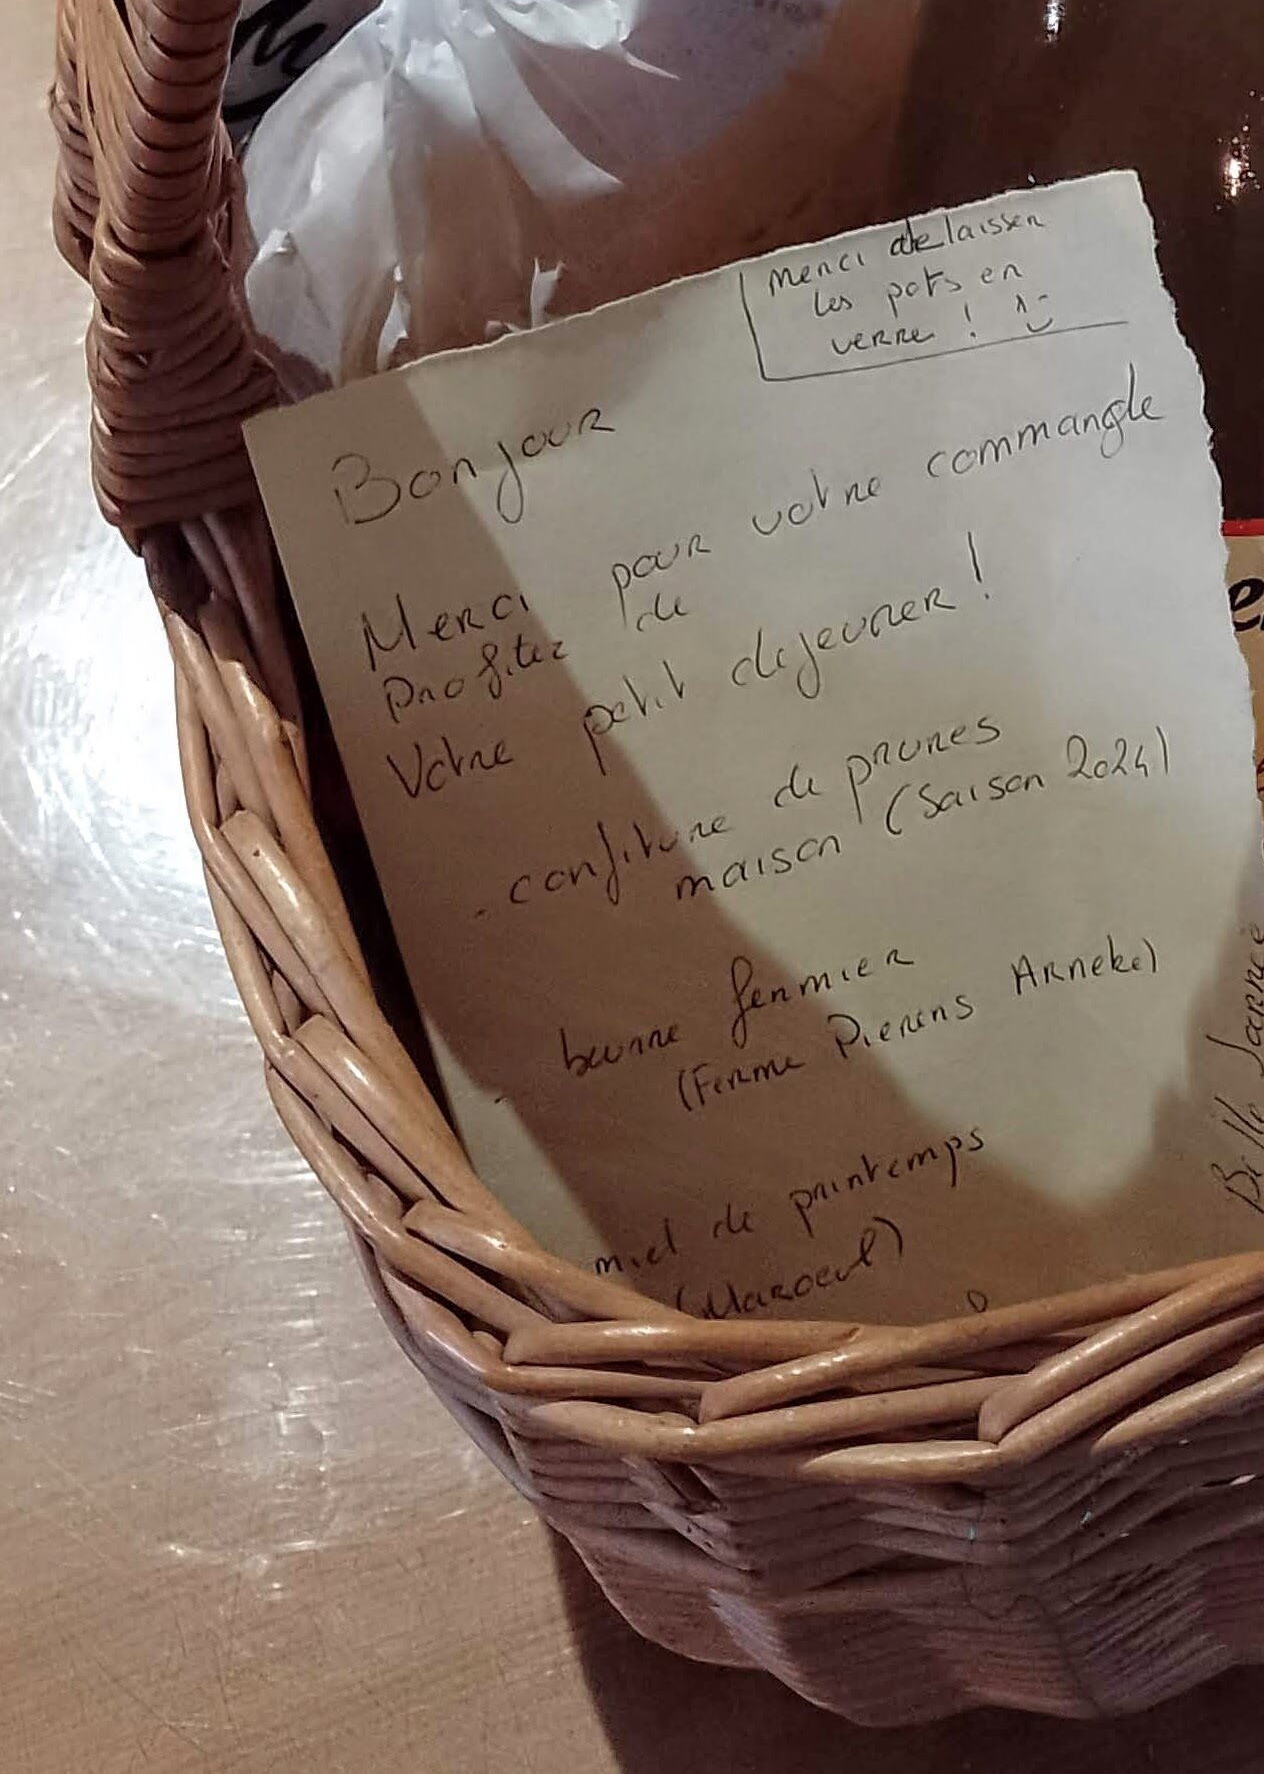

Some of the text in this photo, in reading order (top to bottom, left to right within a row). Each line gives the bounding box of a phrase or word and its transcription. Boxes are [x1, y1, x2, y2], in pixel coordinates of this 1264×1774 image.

[945, 214, 1046, 245] laisser
[831, 326, 937, 356] verre
[888, 267, 962, 318] pots
[981, 262, 1025, 286] en
[331, 409, 615, 524] Bonjour
[360, 593, 529, 672] Merci
[611, 533, 711, 627] pour
[752, 469, 881, 535] votre
[636, 592, 690, 631] de
[583, 660, 687, 776] petit
[773, 763, 822, 809] de
[846, 715, 1001, 825] prunes
[676, 834, 843, 902] maison
[560, 948, 914, 1077] beurre fermier
[595, 1126, 986, 1275] miel de printemps
